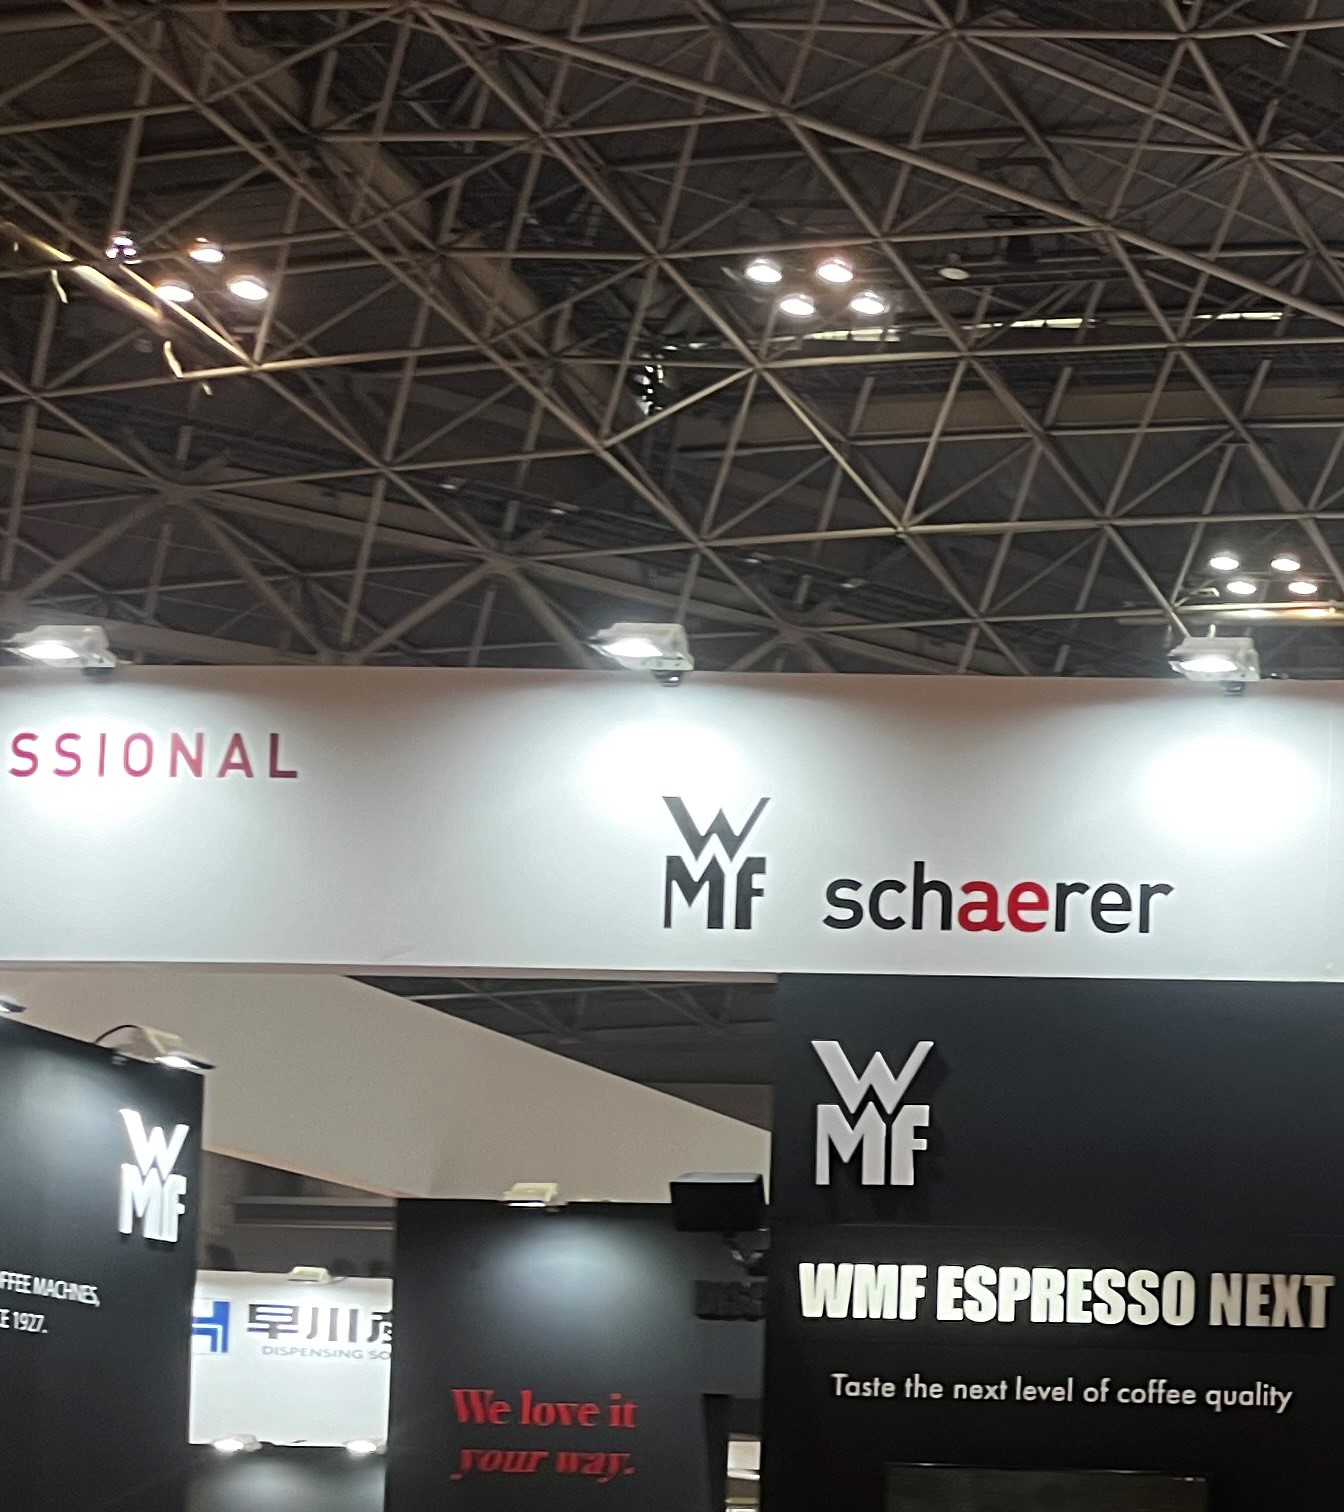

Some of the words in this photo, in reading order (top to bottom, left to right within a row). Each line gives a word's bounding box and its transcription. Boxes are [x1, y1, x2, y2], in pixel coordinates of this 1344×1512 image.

[10, 732, 298, 779] SSIONAL
[662, 796, 771, 930] WMF
[823, 861, 1174, 934] schaerer
[811, 1040, 934, 1187] WMF
[119, 1109, 189, 1243] WMF
[799, 1263, 926, 1321] WMF
[936, 1265, 1195, 1326] ESPRESSO
[1208, 1273, 1335, 1328] NEXT
[13, 1311, 48, 1334] 1927.
[262, 1346, 363, 1359] DISPENSING
[451, 1389, 511, 1424] We
[520, 1389, 599, 1427] love
[609, 1393, 638, 1427] it
[831, 1373, 895, 1398] Taste
[904, 1373, 943, 1399] the
[953, 1379, 1008, 1401] next
[1015, 1375, 1073, 1402] level
[1083, 1377, 1109, 1403] of
[1117, 1379, 1196, 1406] coffee
[1206, 1382, 1292, 1413] quality
[450, 1449, 549, 1480] your
[555, 1452, 635, 1483] way.
